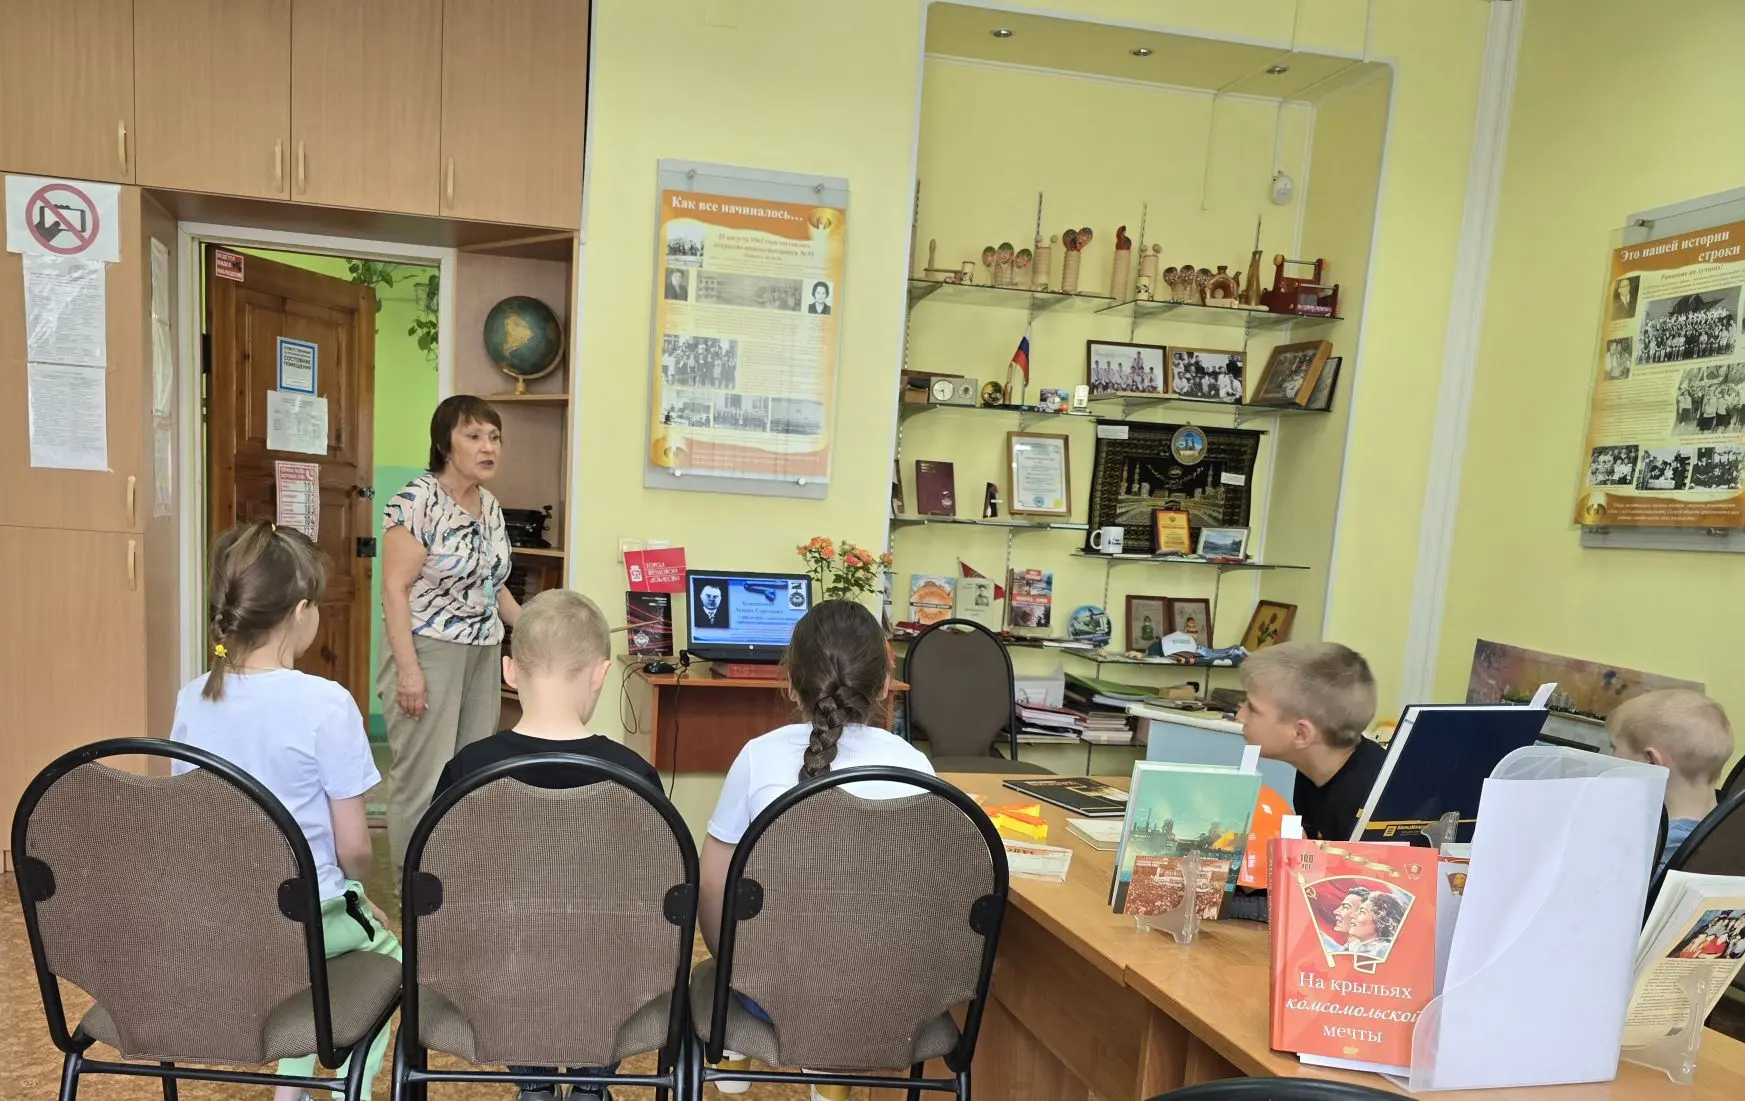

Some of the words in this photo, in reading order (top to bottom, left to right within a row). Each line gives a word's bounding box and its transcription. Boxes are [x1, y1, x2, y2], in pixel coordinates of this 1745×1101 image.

[671, 196, 695, 210] Как
[698, 201, 719, 212] все
[1620, 250, 1640, 262] Это
[1642, 239, 1679, 257] нашей
[1681, 231, 1730, 250] истории
[1698, 244, 1741, 263] строки
[1300, 853, 1314, 864] 100
[1299, 971, 1325, 989] На
[1330, 978, 1413, 999] крыльях
[1322, 1024, 1383, 1044] мечты
